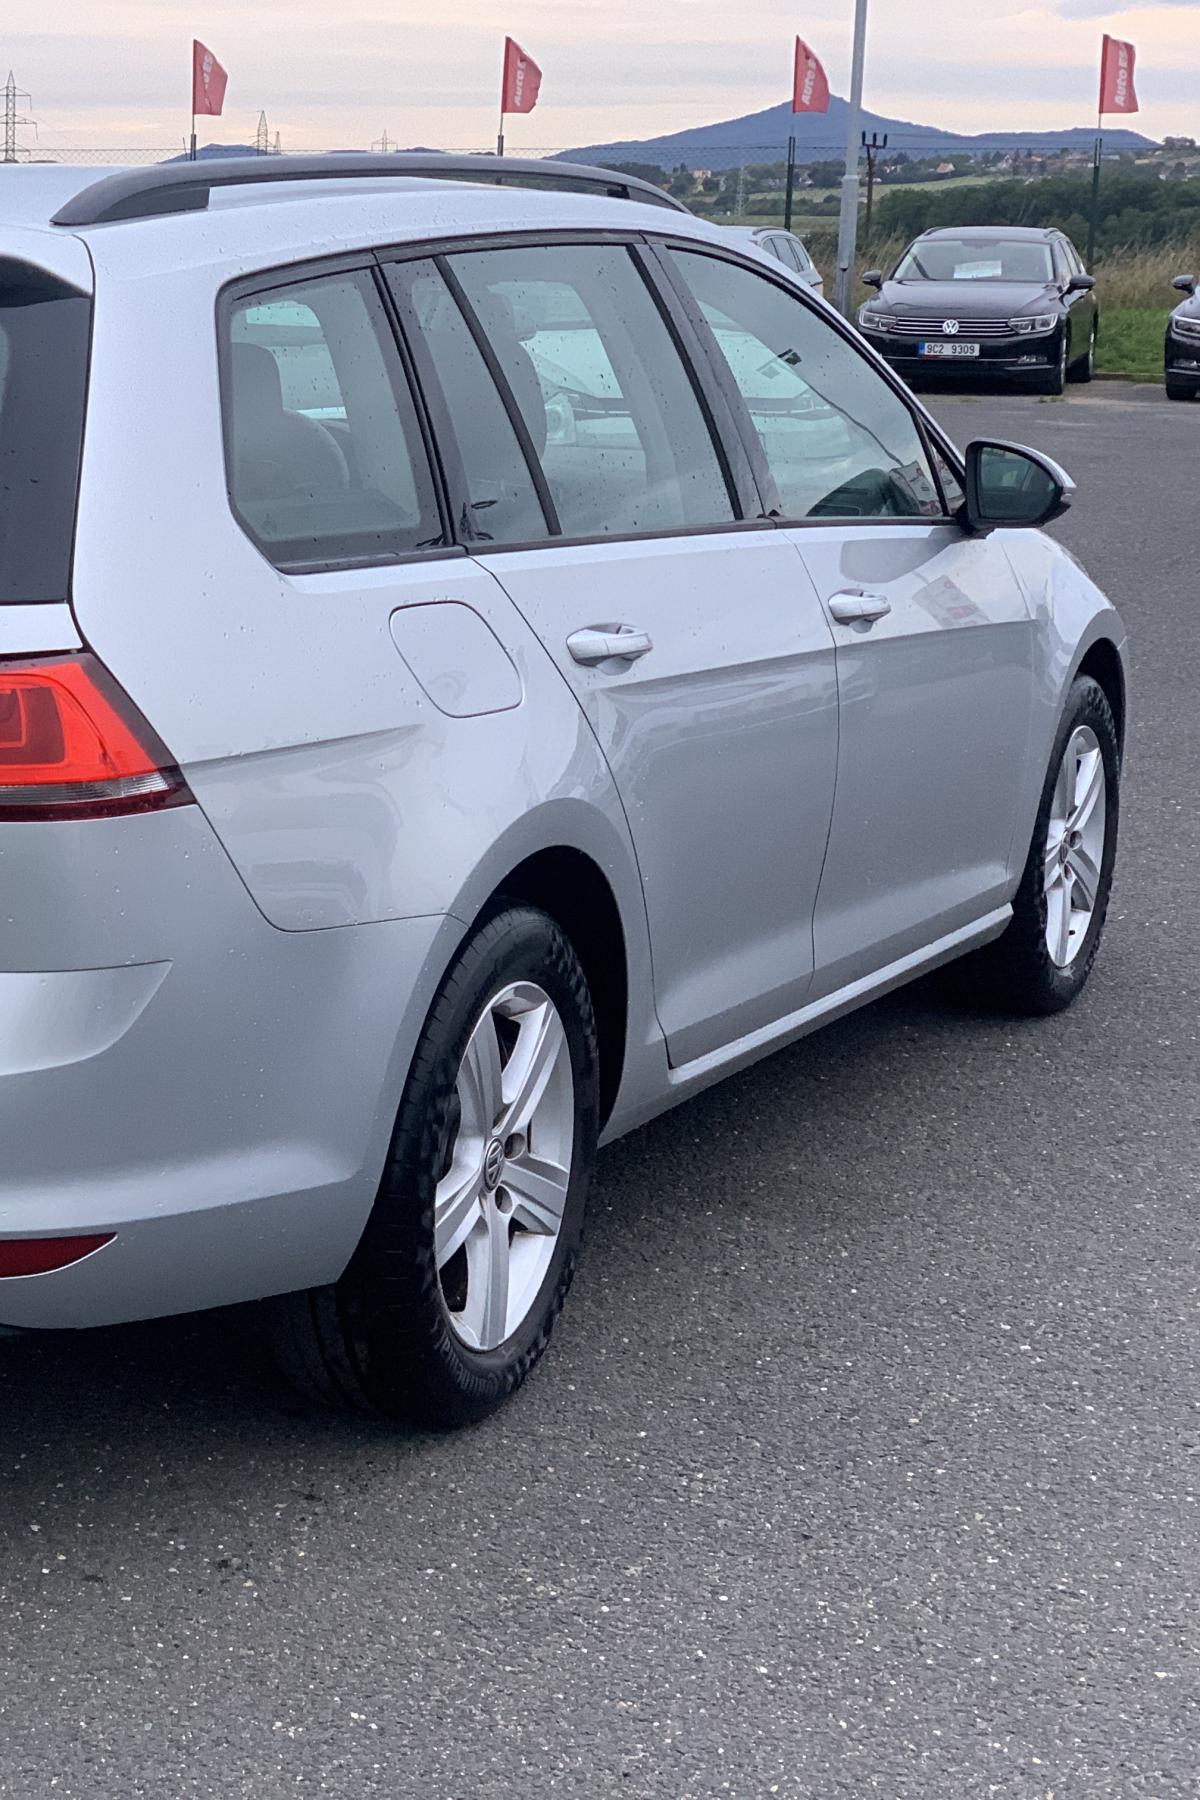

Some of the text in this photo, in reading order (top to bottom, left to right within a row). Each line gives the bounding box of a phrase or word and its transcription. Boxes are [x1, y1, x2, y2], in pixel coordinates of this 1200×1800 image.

[514, 69, 525, 107] Auto
[802, 69, 816, 106] Auto
[1115, 68, 1128, 107] Auto
[927, 344, 975, 354] 9C2 9309
